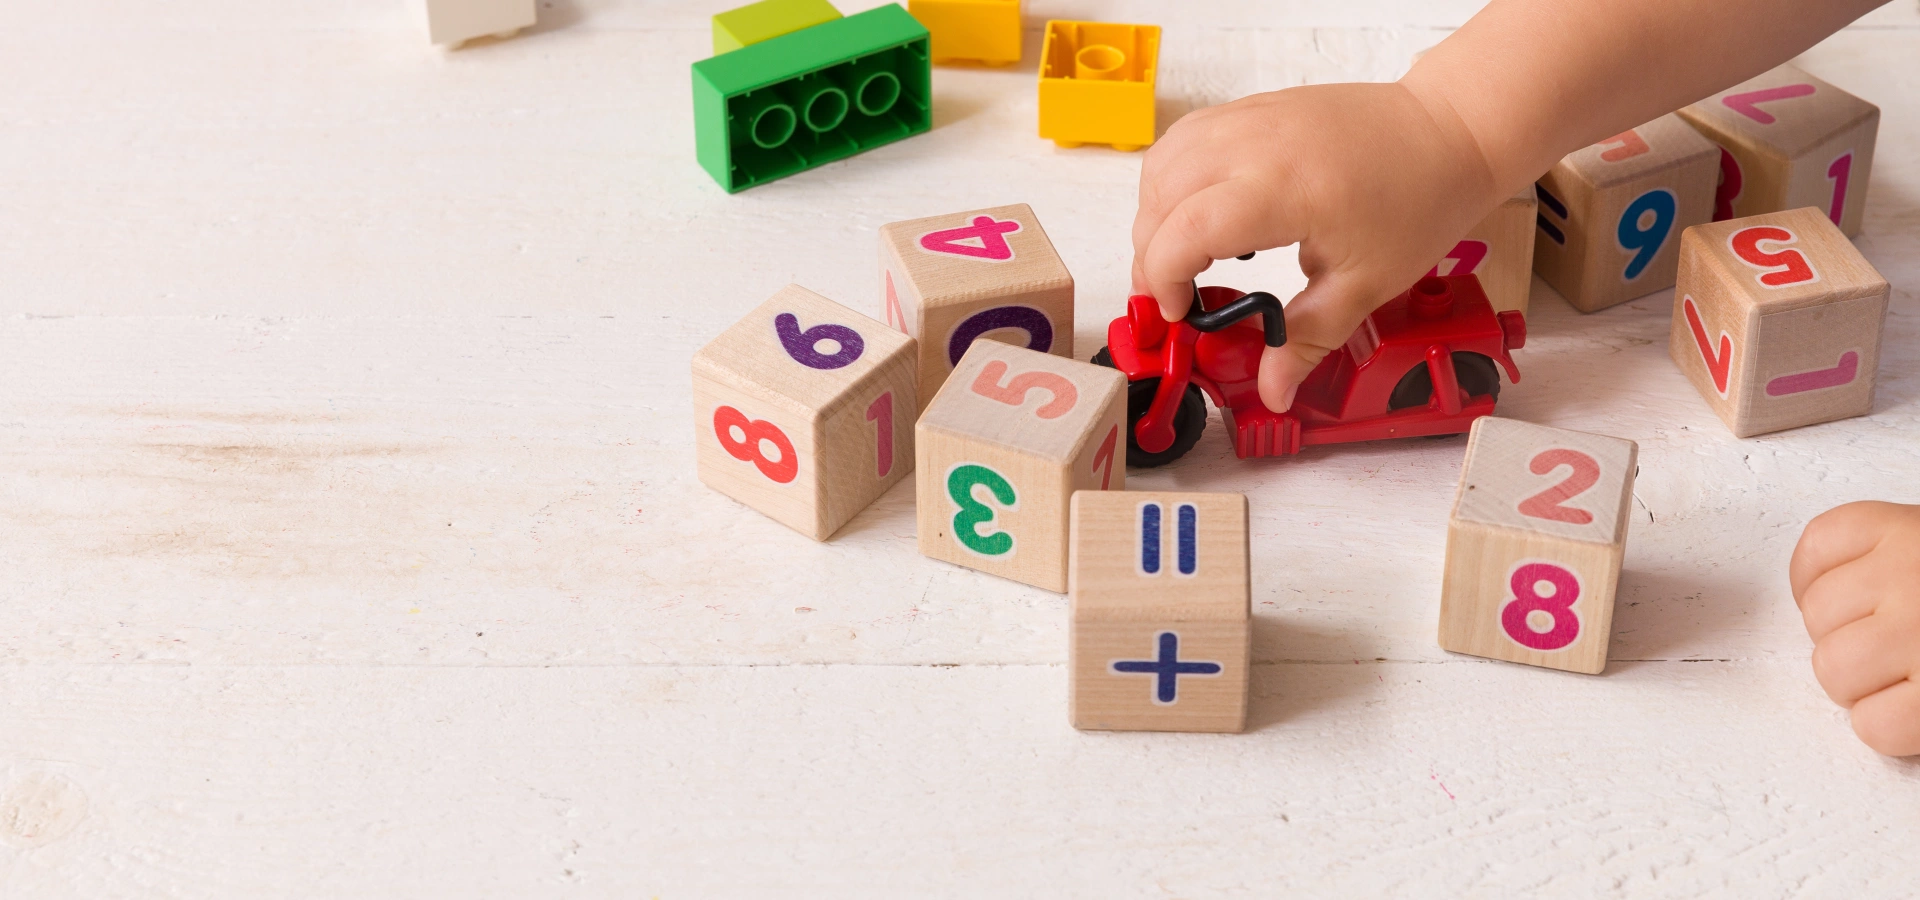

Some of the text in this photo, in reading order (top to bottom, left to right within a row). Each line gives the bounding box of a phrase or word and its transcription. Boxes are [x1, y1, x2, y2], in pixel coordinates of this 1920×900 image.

[1827, 153, 1852, 228] 1
[920, 216, 1019, 260] 4
[1732, 227, 1813, 286] 5
[775, 313, 864, 370] 6
[970, 360, 1078, 419] 5
[713, 405, 798, 483] 8
[866, 391, 893, 477] 1
[948, 465, 1016, 555] 3
[1518, 448, 1600, 525] 2
[1501, 563, 1580, 650] 8
